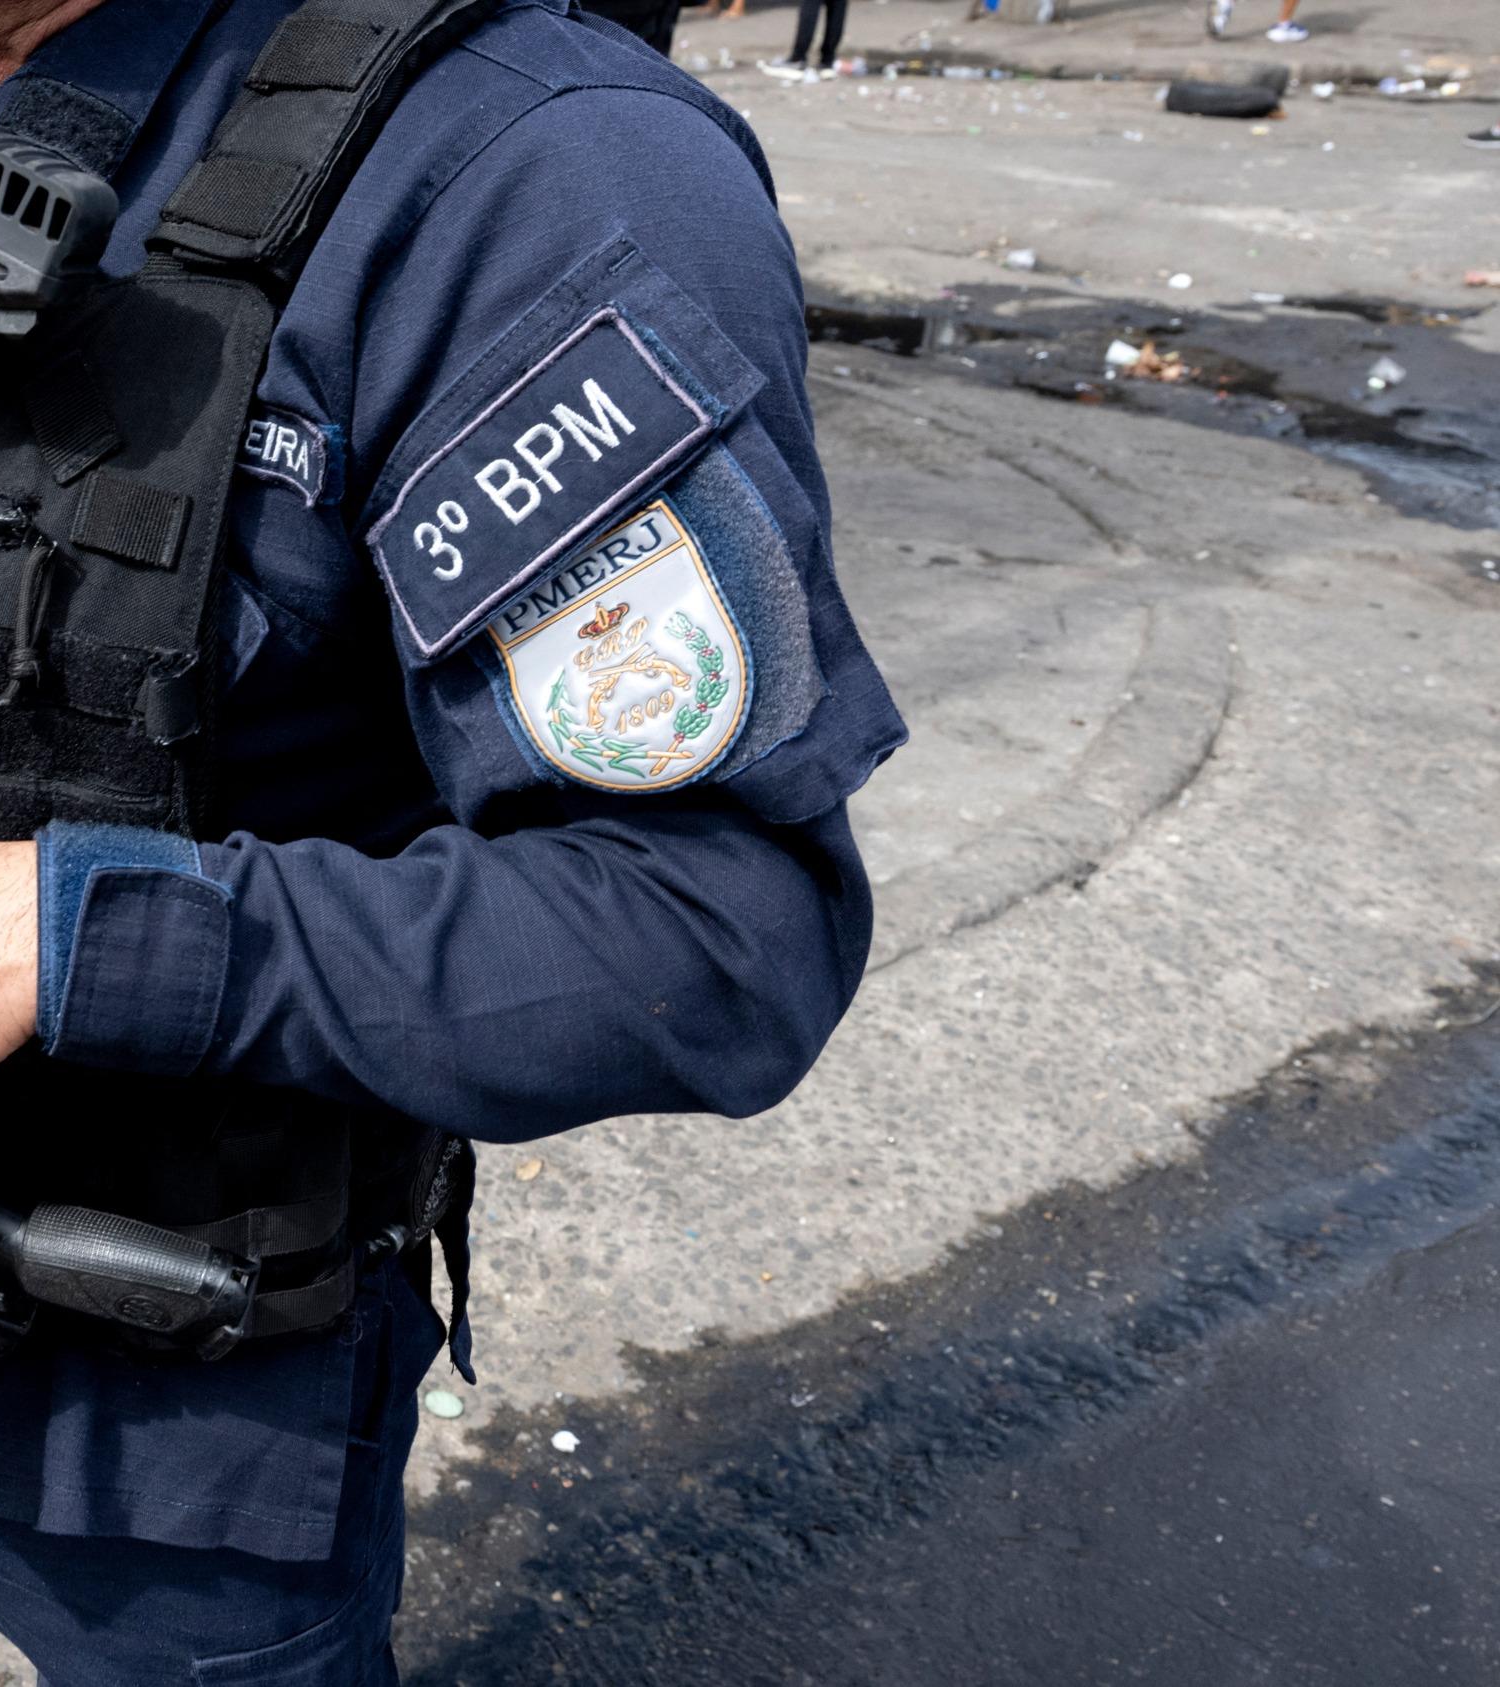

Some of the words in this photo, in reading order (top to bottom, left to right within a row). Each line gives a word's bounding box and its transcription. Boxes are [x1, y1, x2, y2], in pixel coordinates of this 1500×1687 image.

[244, 419, 309, 480] EIRA
[474, 377, 636, 526] BPM
[502, 517, 662, 635] PMERJ
[614, 689, 675, 735] 1809
